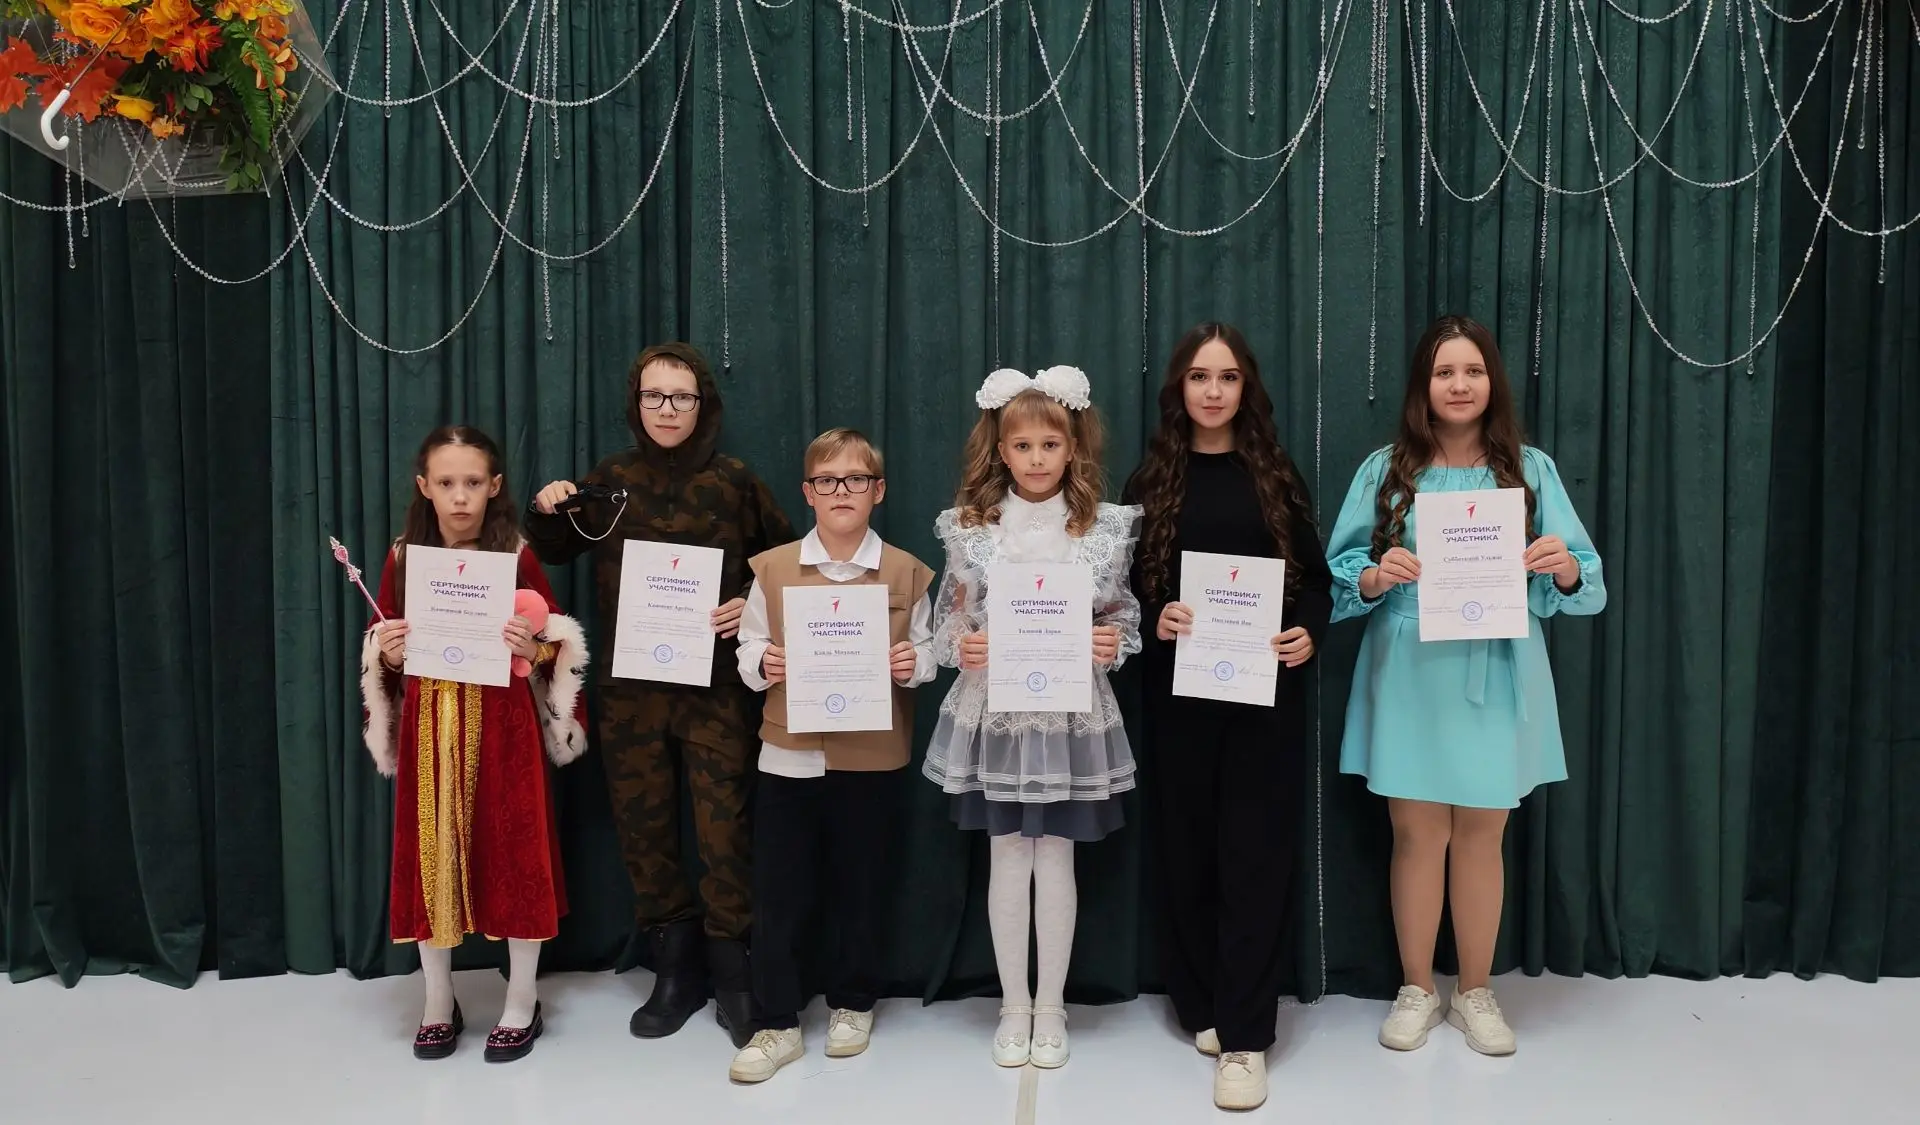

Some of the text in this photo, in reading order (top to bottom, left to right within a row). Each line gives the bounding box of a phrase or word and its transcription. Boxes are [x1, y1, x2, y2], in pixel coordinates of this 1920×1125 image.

[1442, 525, 1502, 535] СЕРТИФИКАТ
[1446, 534, 1499, 543] УЧАСТНИКА
[430, 580, 491, 591] СЕРТИФИКАТ
[646, 575, 700, 586] СЕРТИФИКАТ
[433, 588, 487, 599] УЧАСТНИКА
[648, 583, 697, 594] УЧАСТНИКА
[1205, 588, 1262, 599] СЕРТИФИКАТ
[1010, 599, 1068, 607] СЕРТИФИКАТ
[1208, 597, 1258, 608] УЧАСТНИКА
[807, 621, 865, 629] СЕРТИФИКАТ
[811, 629, 863, 637] УЧАСТНИКА
